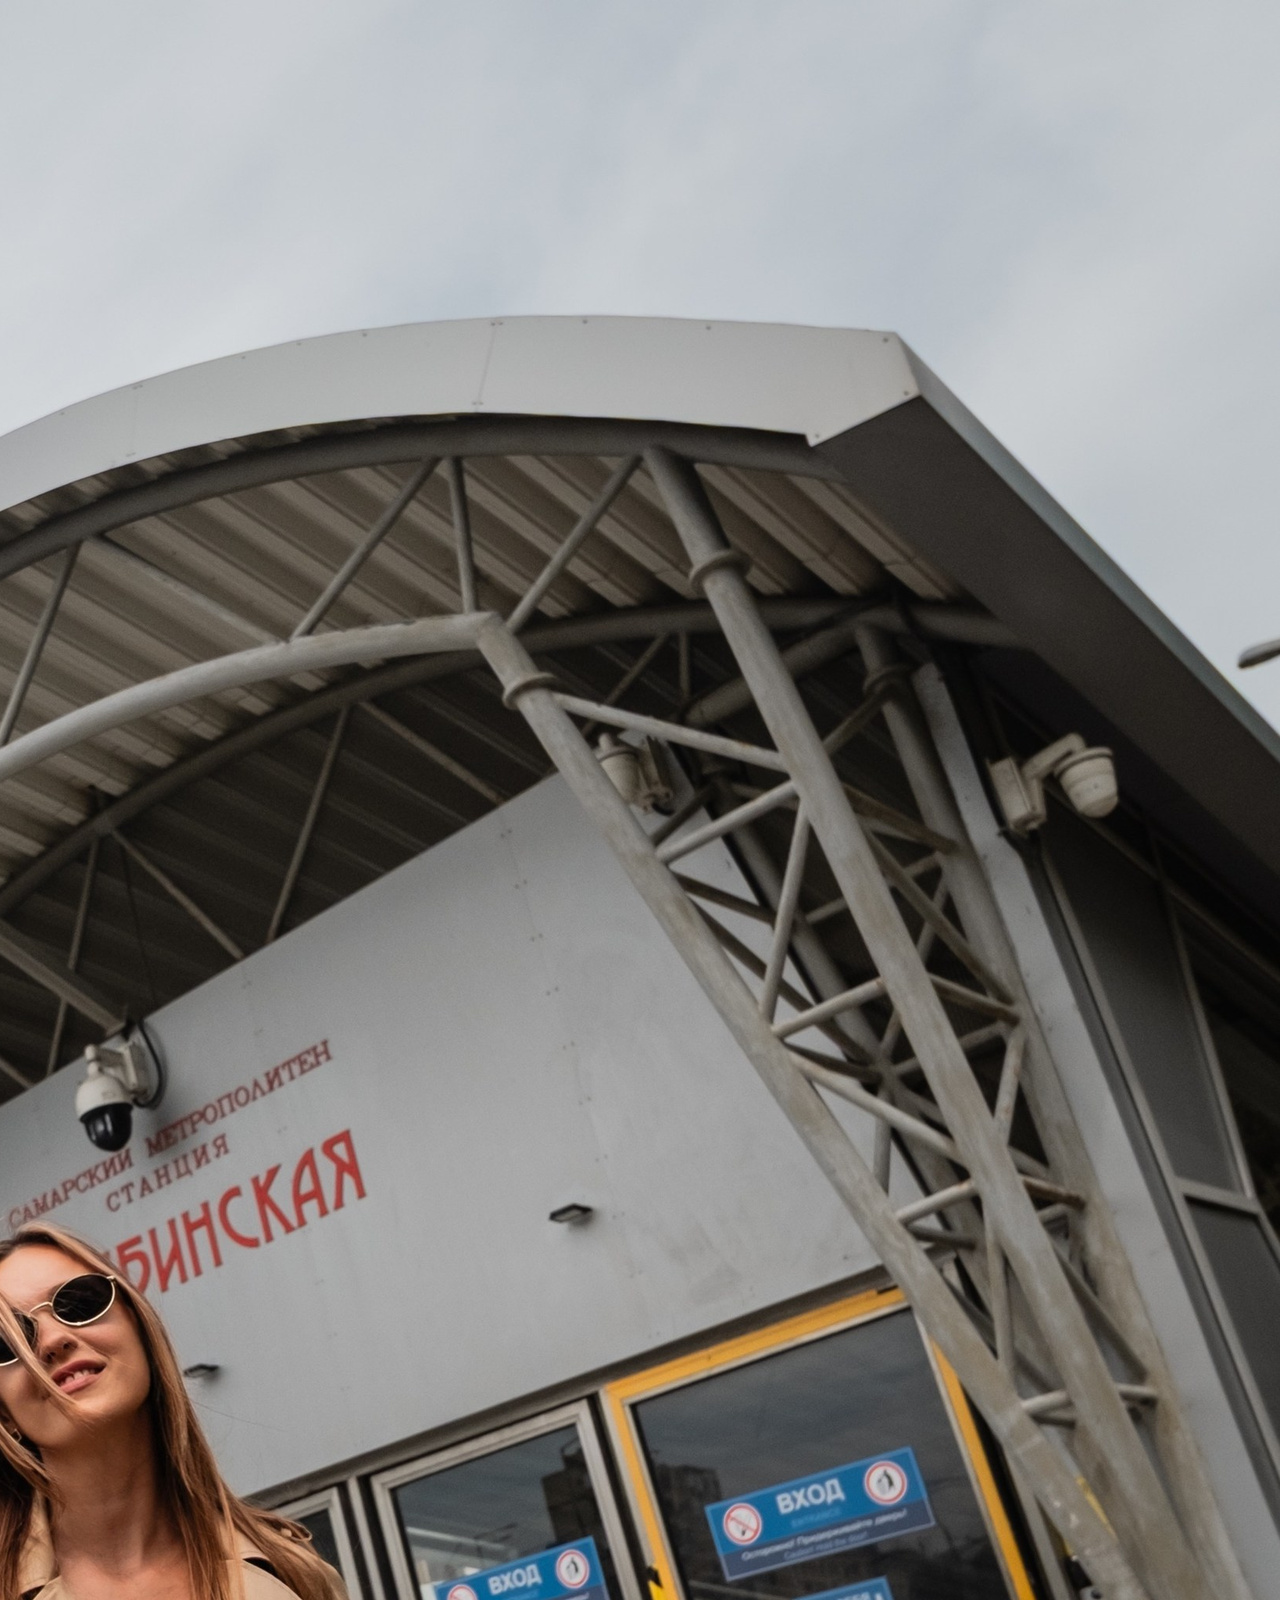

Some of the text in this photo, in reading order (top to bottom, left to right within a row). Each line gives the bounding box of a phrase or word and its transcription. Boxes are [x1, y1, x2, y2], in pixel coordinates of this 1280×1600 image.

[145, 1039, 334, 1157] МЕТРОПОЛИТЕН
[104, 1128, 367, 1294] БИНСКАЯ
[105, 1133, 231, 1213] СТАНЦИЯ
[775, 1478, 846, 1515] ВХОД
[487, 1563, 543, 1596] ВХОД
